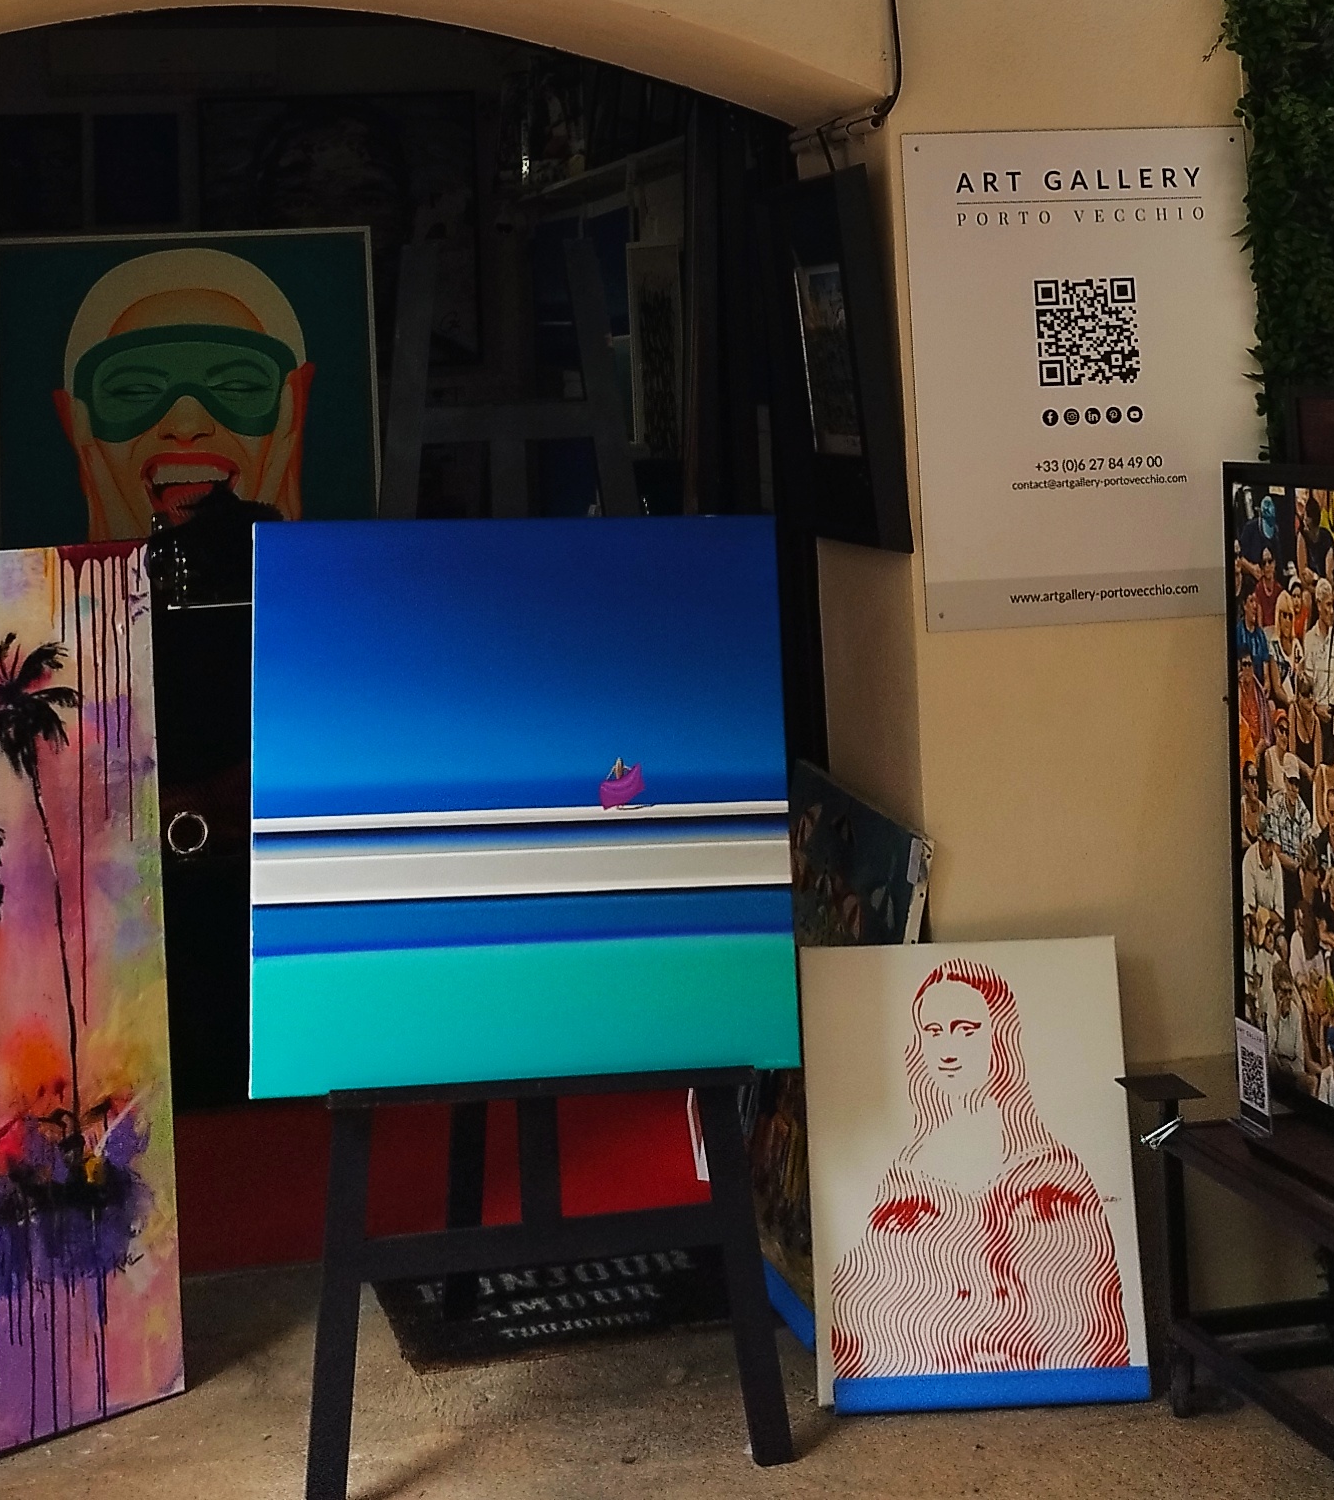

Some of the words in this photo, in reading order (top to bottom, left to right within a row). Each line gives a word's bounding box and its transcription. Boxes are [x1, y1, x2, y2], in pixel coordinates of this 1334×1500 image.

[956, 171, 1022, 194] ART
[1044, 167, 1200, 191] GALLERY
[957, 210, 1051, 227] PORTO
[1073, 206, 1204, 223] VECCHIO
[1035, 459, 1060, 473] +33
[1062, 458, 1086, 474] (0)6
[1089, 458, 1105, 471] 27
[1108, 457, 1124, 470] 84
[1127, 456, 1143, 469] 49
[1146, 455, 1163, 469] 00
[1011, 473, 1188, 491] contact@artgallery-portovecchio.com
[1009, 583, 1199, 604] www.artgallery-portovecchio.com
